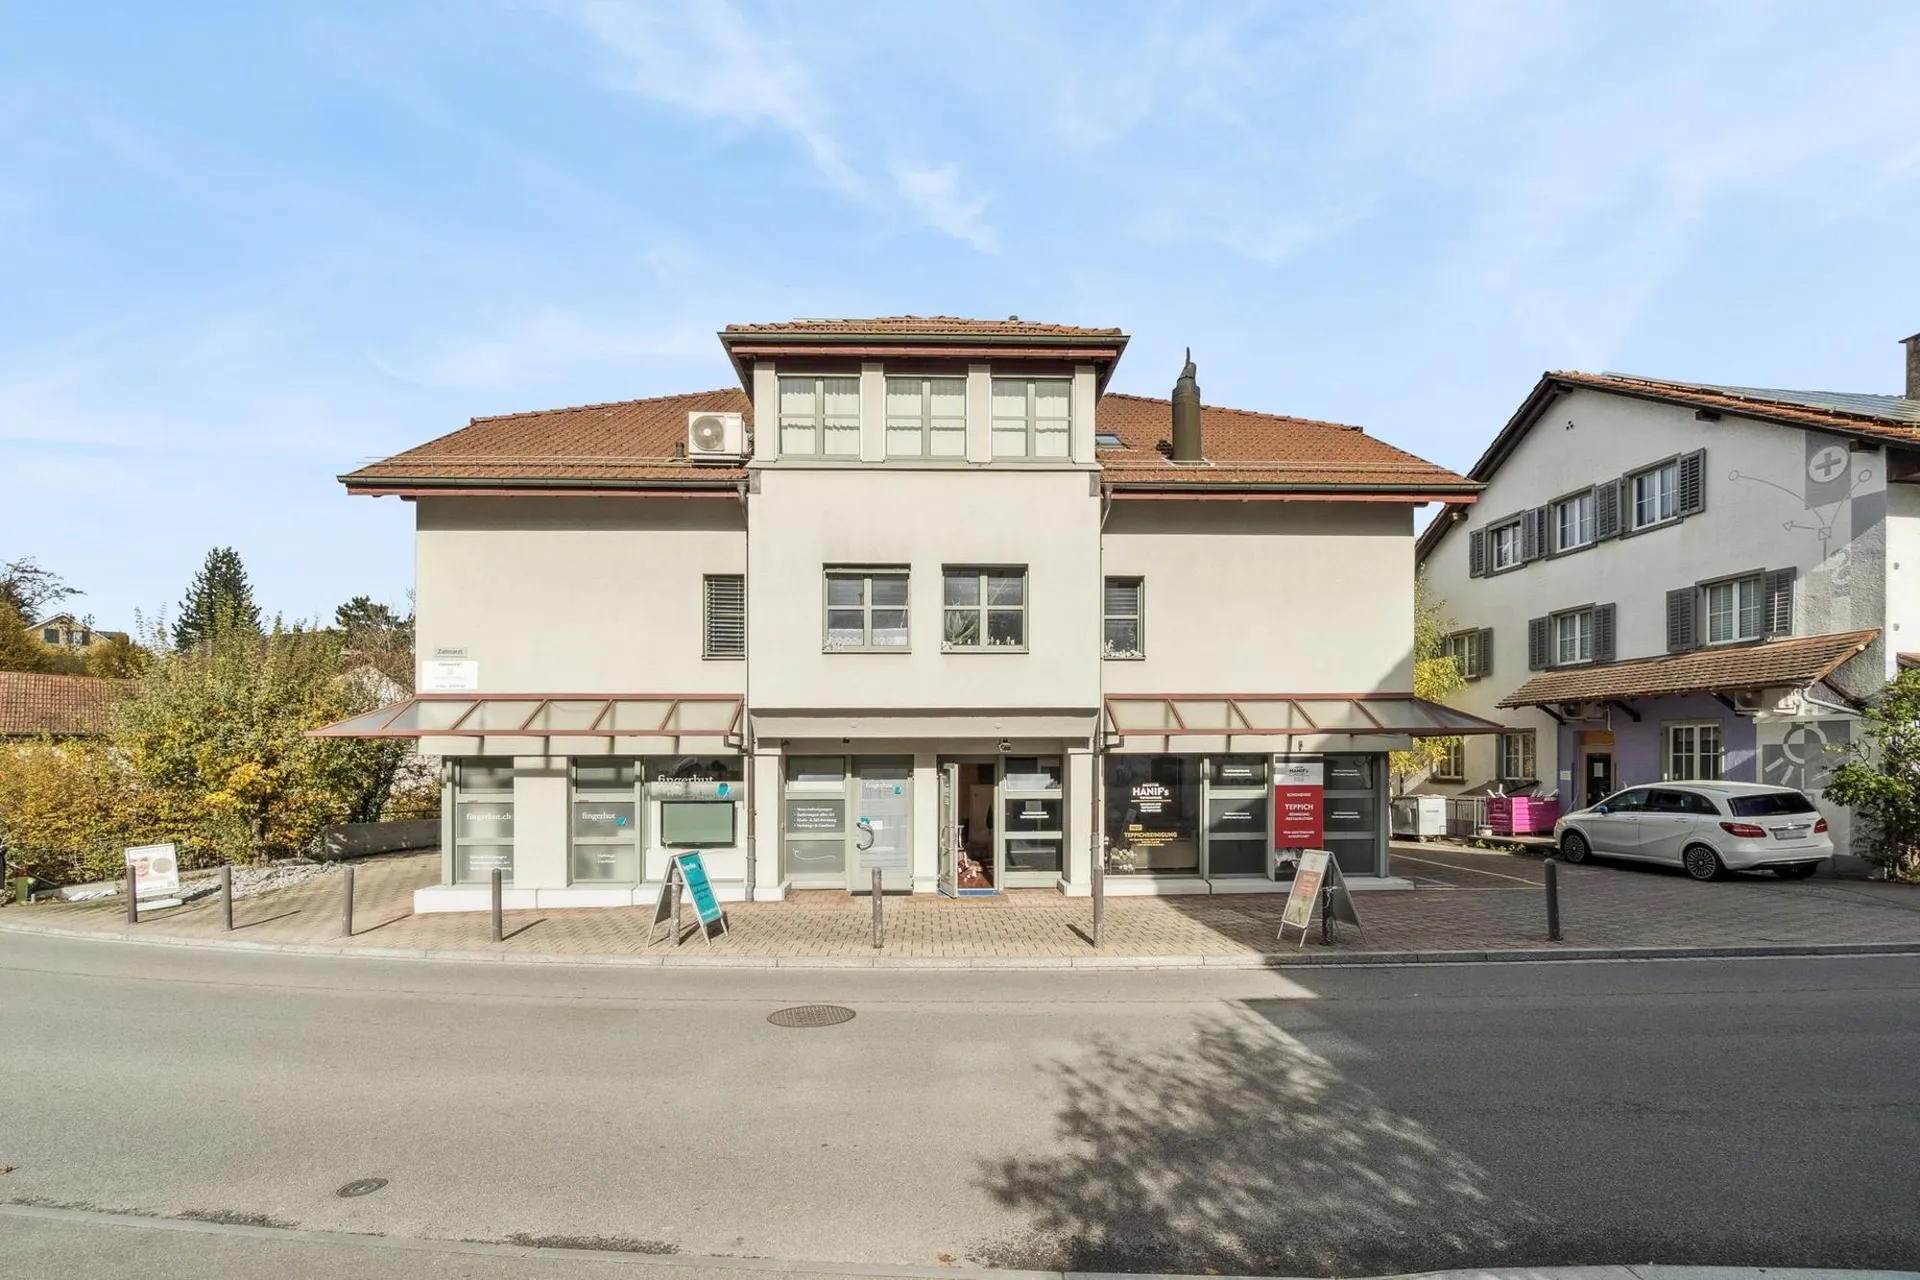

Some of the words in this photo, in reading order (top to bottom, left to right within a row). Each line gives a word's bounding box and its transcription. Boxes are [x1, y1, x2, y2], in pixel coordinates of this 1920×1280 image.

[1132, 787, 1169, 796] HANIF's
[1285, 803, 1314, 811] TEPPICH
[582, 811, 616, 821] fingerhut
